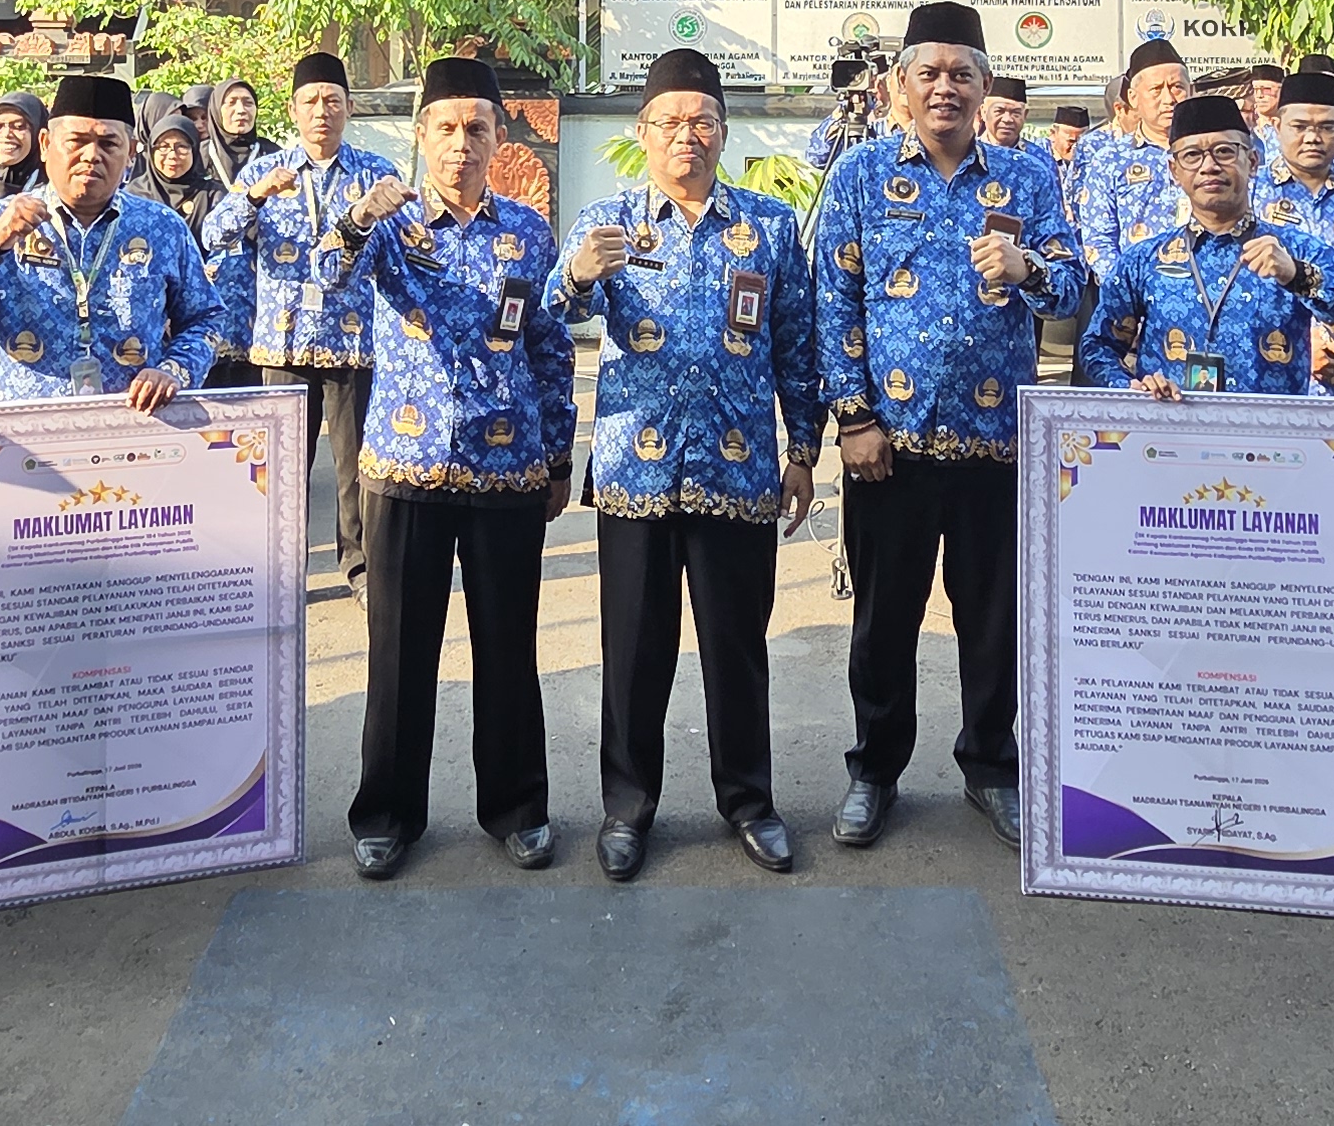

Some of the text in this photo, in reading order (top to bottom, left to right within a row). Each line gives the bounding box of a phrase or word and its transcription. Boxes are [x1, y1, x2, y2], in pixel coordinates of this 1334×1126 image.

[784, 1, 801, 9] DAN
[803, 1, 858, 9] PELESTARIAN
[861, 1, 915, 9] PERKAWINAN
[1184, 19, 1249, 37] KORP
[621, 53, 659, 61] KANTOR
[728, 52, 760, 61] AGAMA
[790, 54, 827, 62] KANTOR
[1005, 55, 1070, 63] KEMENTERIAN
[1073, 55, 1104, 63] AGAMA
[1245, 56, 1277, 64] AGAMA
[989, 64, 1082, 72] ABUPATEN PURBALINGGA
[13, 503, 194, 540] MAKLUMAT LAYANAN
[1139, 505, 1319, 535] MAKLUMAT LAYANAN
[0, 638, 35, 650] SANKSI
[42, 633, 75, 646] SESUAI
[81, 627, 136, 641] PERATURAN
[142, 615, 254, 635] PERUNDANG-UNDANGAN
[71, 665, 132, 680] KOMPENSASI
[1197, 671, 1257, 683] KOMPENSASI
[1073, 729, 1117, 740] PETUGAS
[1117, 731, 1141, 741] KAMI
[1142, 732, 1164, 743] SIAP
[1164, 734, 1223, 747] MENGANTAR
[1223, 738, 1263, 749] PRODUK
[1264, 741, 1308, 752] LAYANAN
[11, 798, 59, 812] MADRASAH
[104, 788, 135, 799] NEGERI
[141, 779, 197, 794] PURBALINGGA
[1212, 793, 1243, 803] KEPALA
[1132, 795, 1178, 806] MADRASAH
[1232, 802, 1262, 812] NEGERI
[1268, 804, 1327, 816] PURBALINGGA
